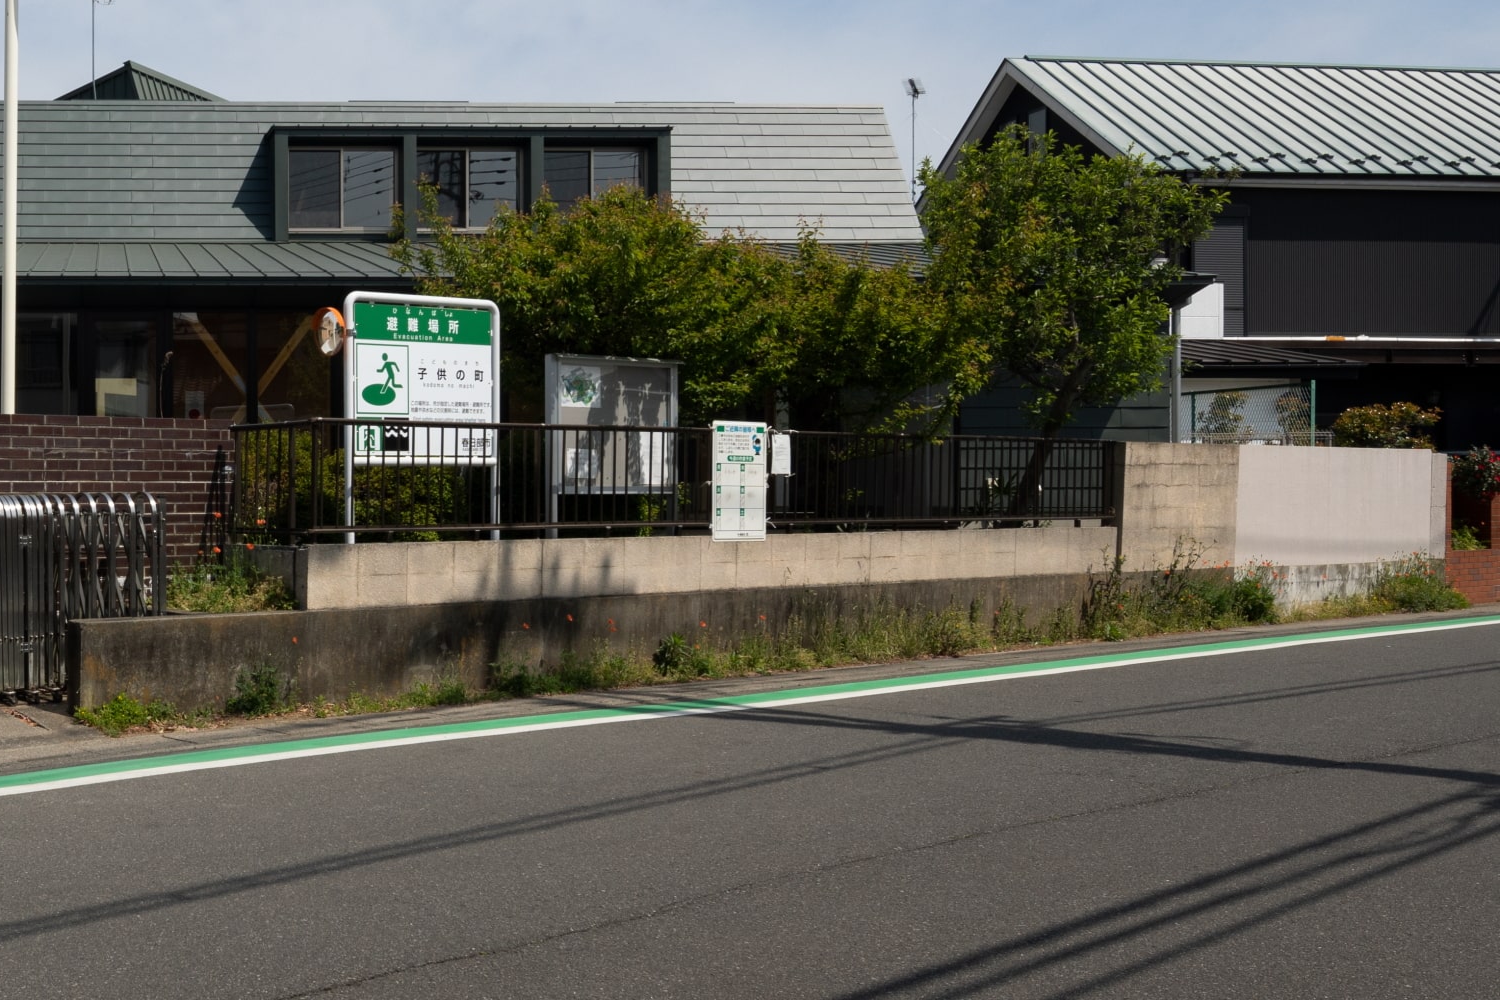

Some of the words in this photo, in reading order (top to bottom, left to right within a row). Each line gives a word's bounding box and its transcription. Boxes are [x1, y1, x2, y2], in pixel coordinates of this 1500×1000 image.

[386, 316, 459, 334] 避難場所
[417, 367, 484, 382] 子供の町
